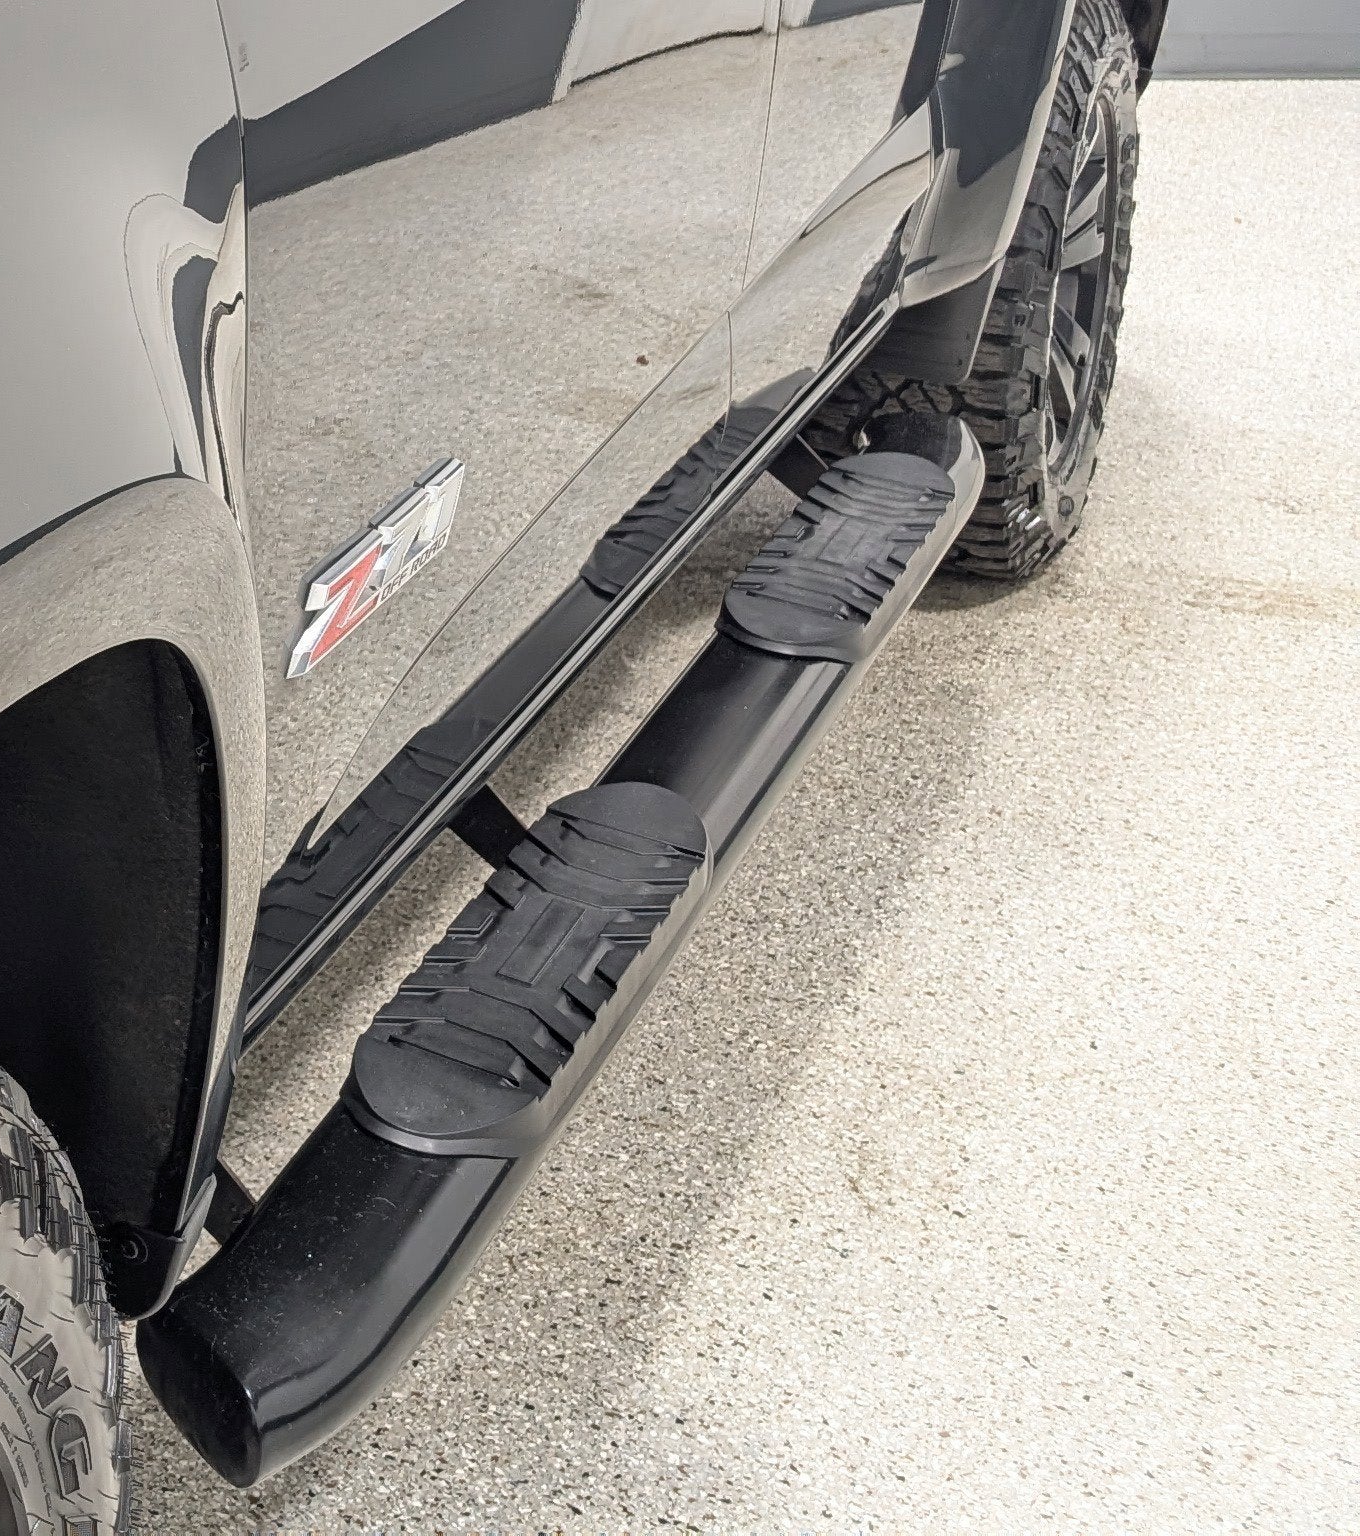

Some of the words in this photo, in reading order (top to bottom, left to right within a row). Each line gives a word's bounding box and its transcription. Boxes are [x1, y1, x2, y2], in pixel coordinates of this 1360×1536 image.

[286, 458, 465, 679] Z71
[381, 569, 411, 602] OFF
[411, 535, 447, 575] ROAD
